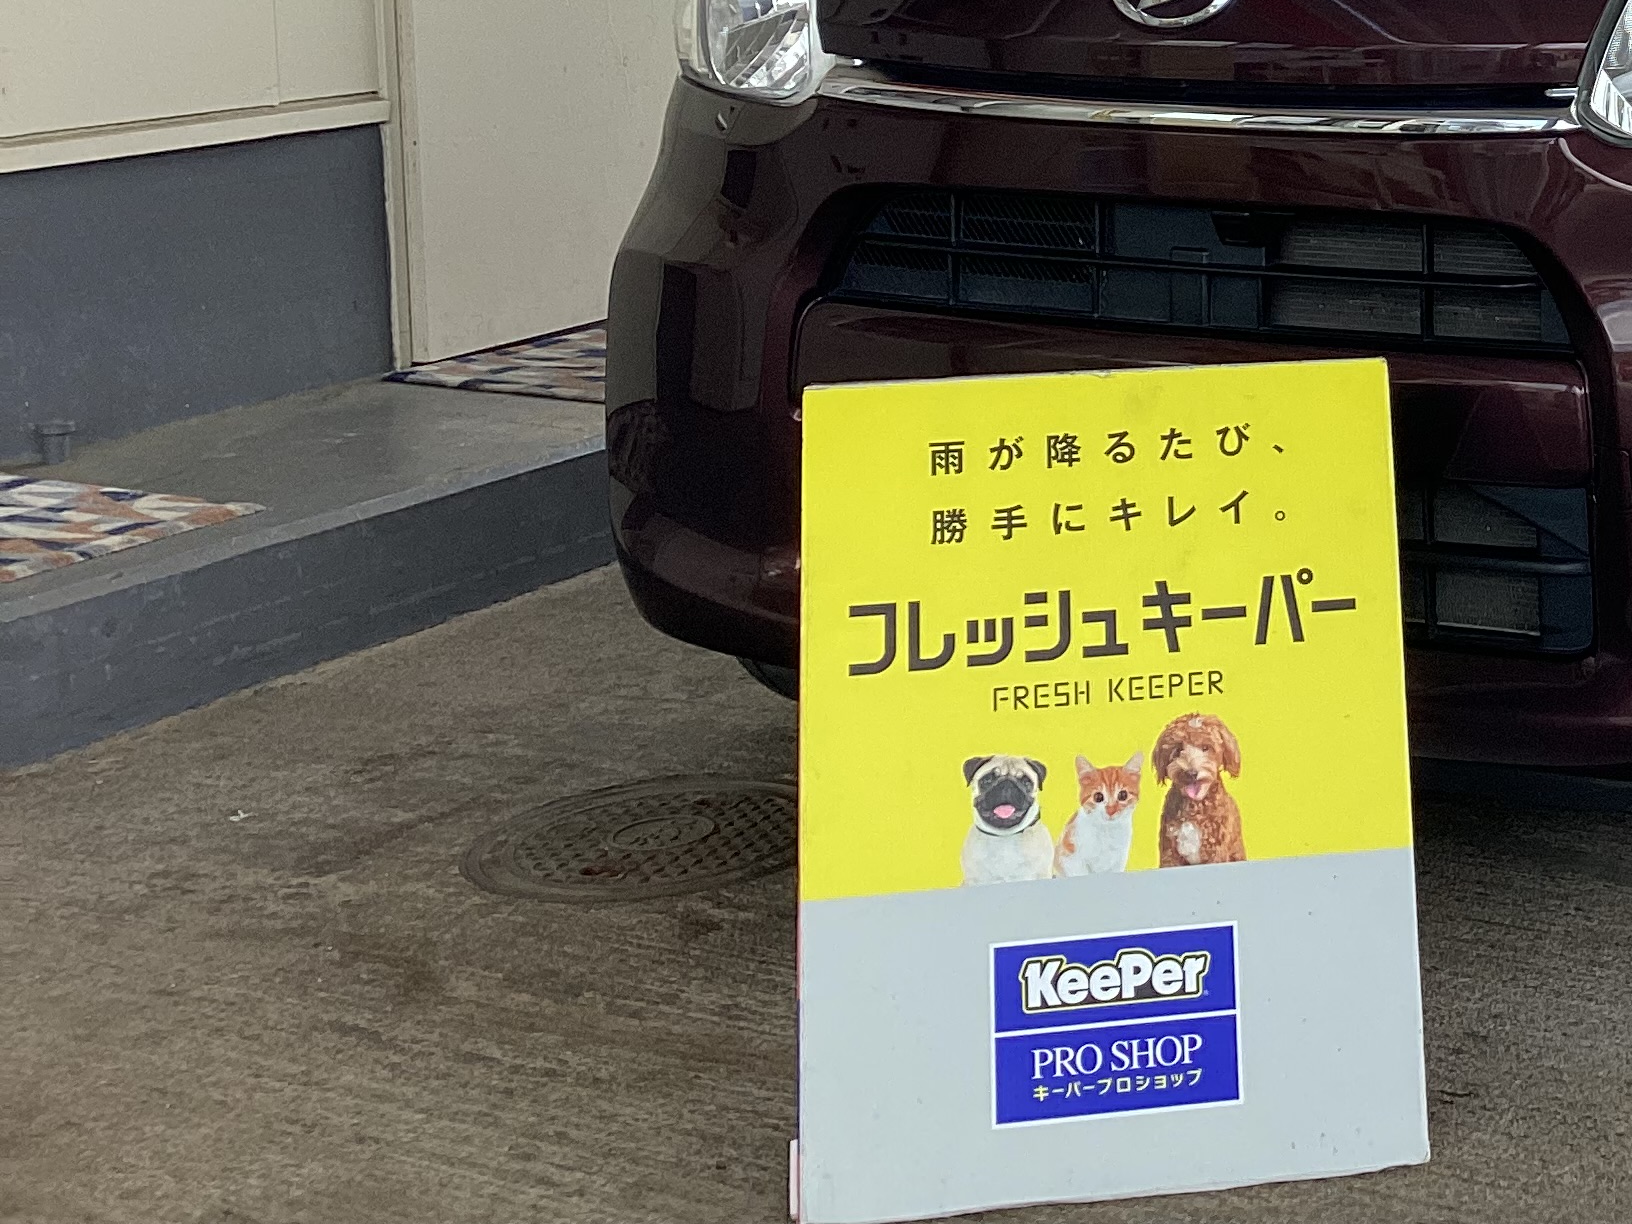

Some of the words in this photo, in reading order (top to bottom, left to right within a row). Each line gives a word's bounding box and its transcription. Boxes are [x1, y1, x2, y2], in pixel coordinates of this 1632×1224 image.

[927, 421, 1286, 476] 雨が降るたび、
[930, 488, 1287, 545] 勝手にキレイ。
[847, 567, 1357, 677] フレッシュキーパー
[992, 681, 1092, 713] FRESH
[1108, 670, 1225, 703] KEEPER
[1020, 949, 1209, 1012] KeePer
[1031, 1043, 1103, 1080] PRO
[1110, 1033, 1203, 1073] SHOP
[1032, 1067, 1203, 1102] キーパープロショップ
